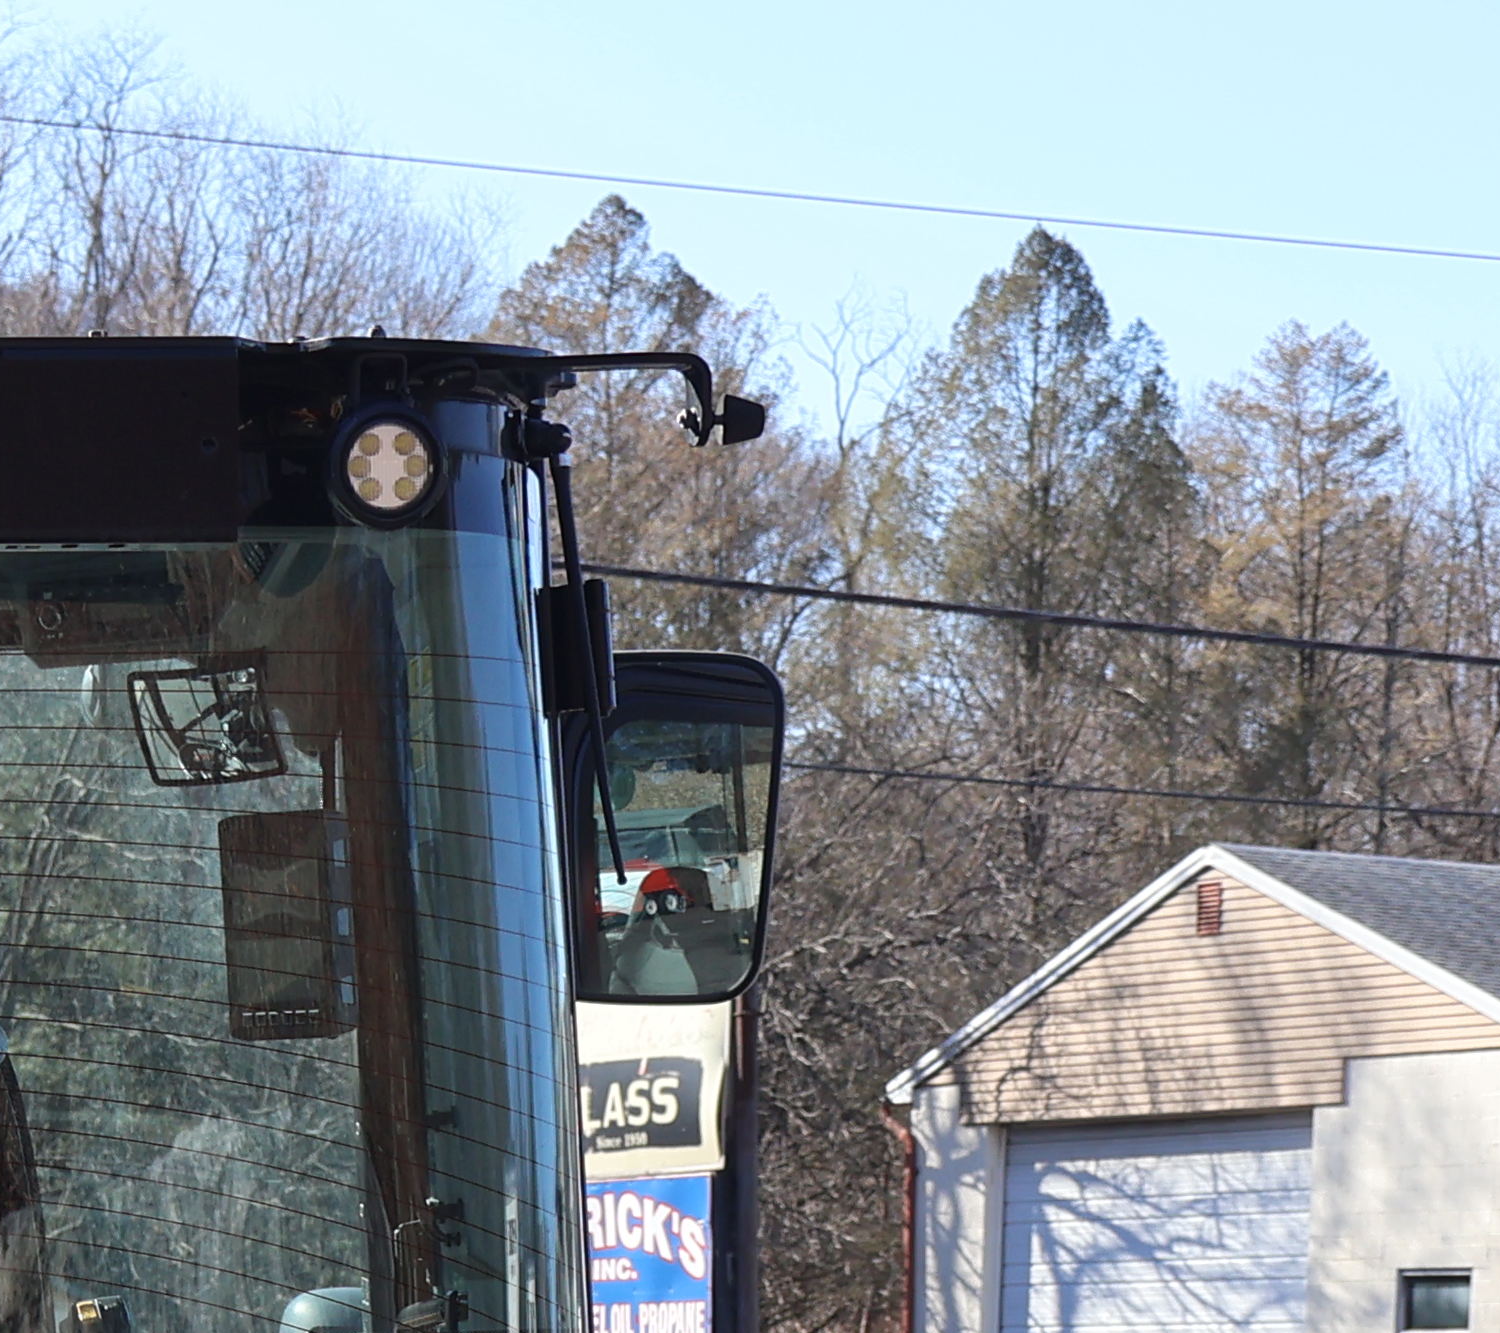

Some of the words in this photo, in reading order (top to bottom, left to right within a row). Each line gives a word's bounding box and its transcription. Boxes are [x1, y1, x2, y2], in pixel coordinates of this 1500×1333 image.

[581, 1076, 680, 1132] LASS
[587, 1191, 707, 1279] RICK'S
[592, 1258, 639, 1280] INC.
